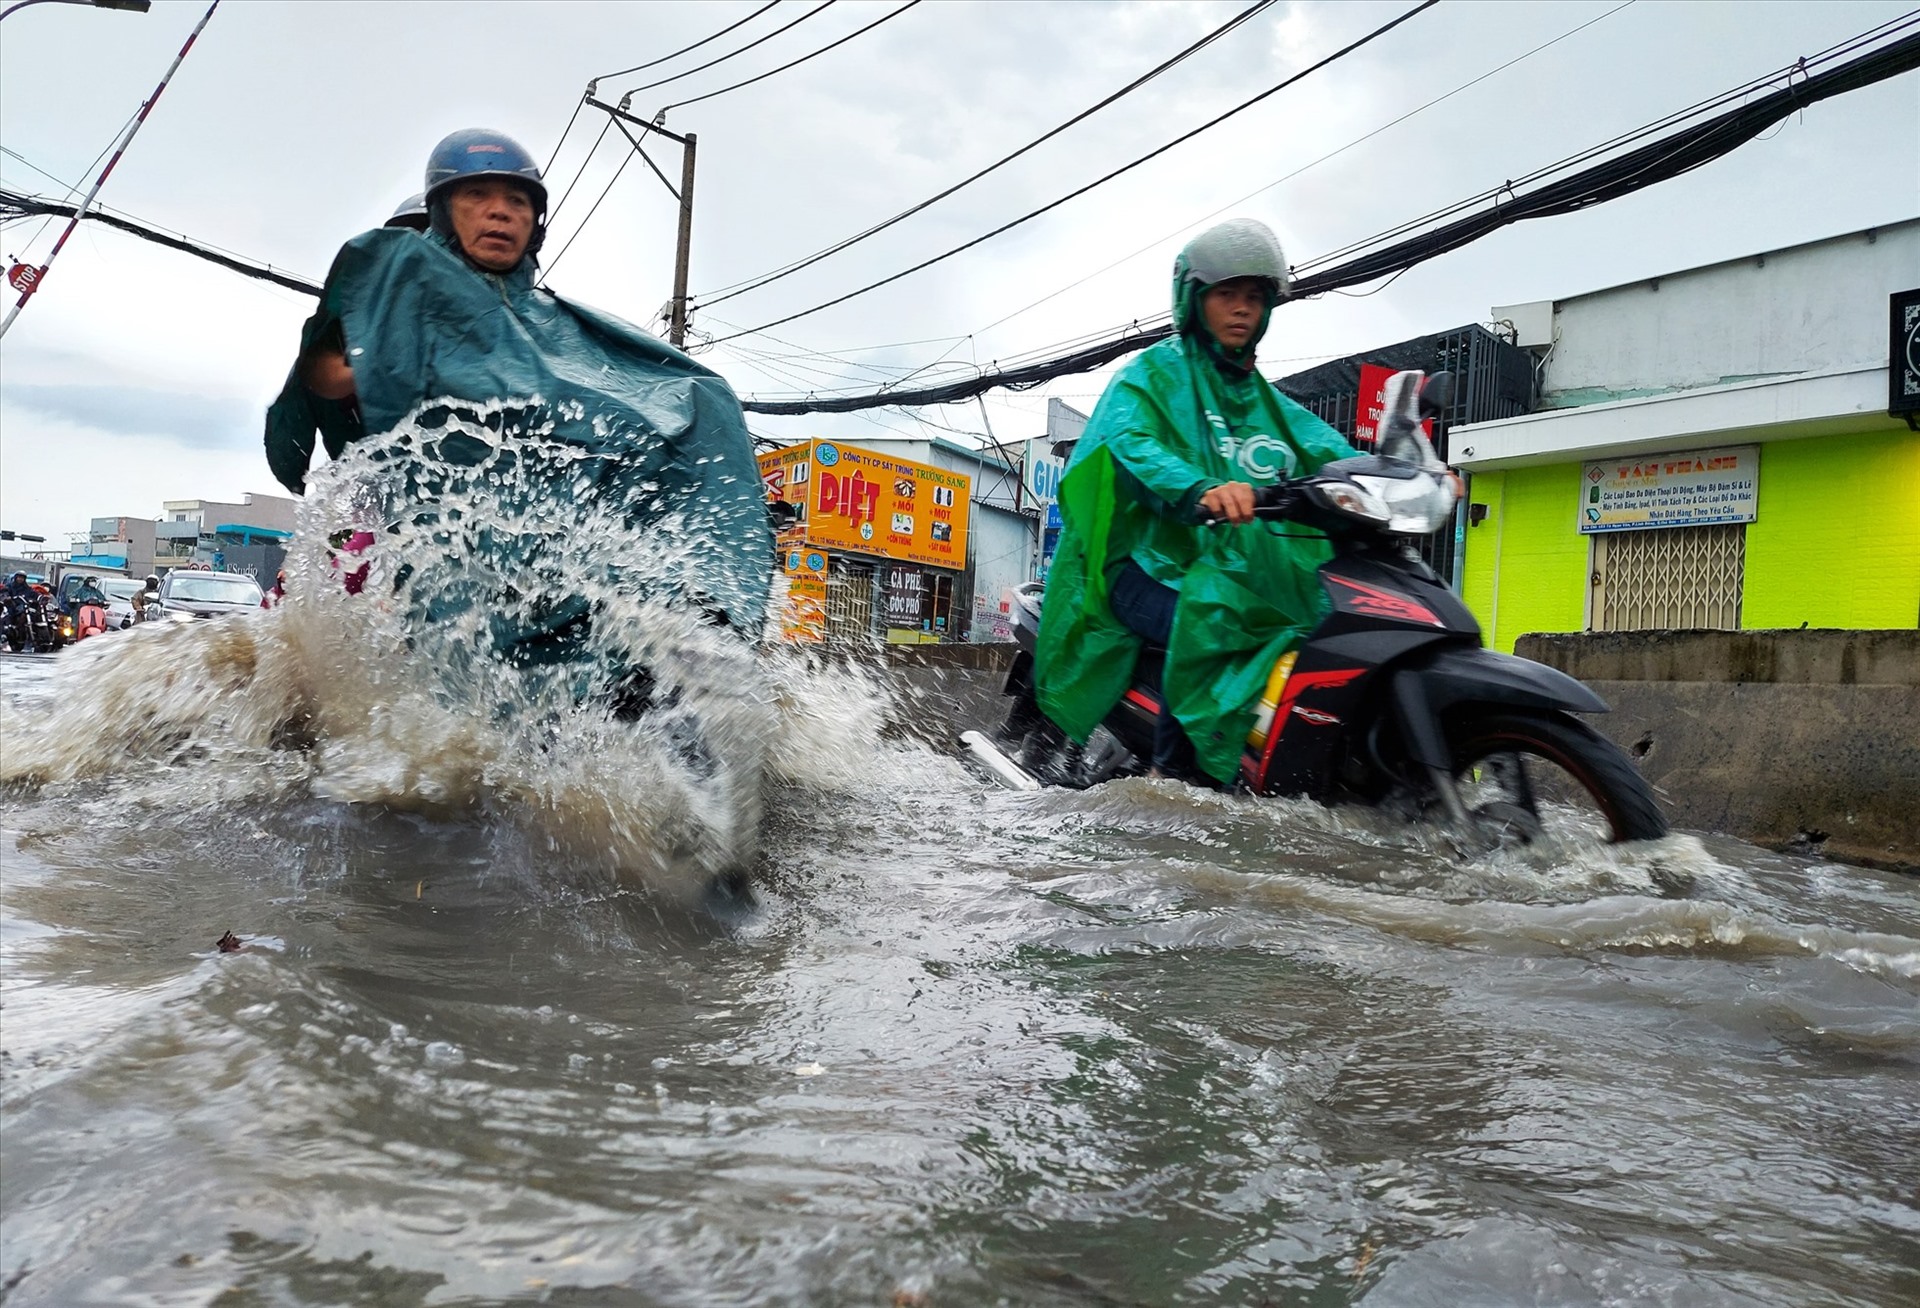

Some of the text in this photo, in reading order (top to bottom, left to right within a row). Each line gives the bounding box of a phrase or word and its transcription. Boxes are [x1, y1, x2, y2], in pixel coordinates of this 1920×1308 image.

[13, 265, 37, 292] STOP
[863, 456, 872, 466] TY
[946, 476, 966, 489] SANG
[1664, 455, 1737, 475] THÀNH
[818, 468, 880, 529] DIỆT
[1625, 490, 1635, 499] Bao
[1636, 489, 1644, 498] Da
[1738, 480, 1743, 489] &
[934, 508, 952, 521] MỌT
[891, 567, 922, 590] CÀ PHÊ
[889, 591, 921, 615] GÓC PHỐ
